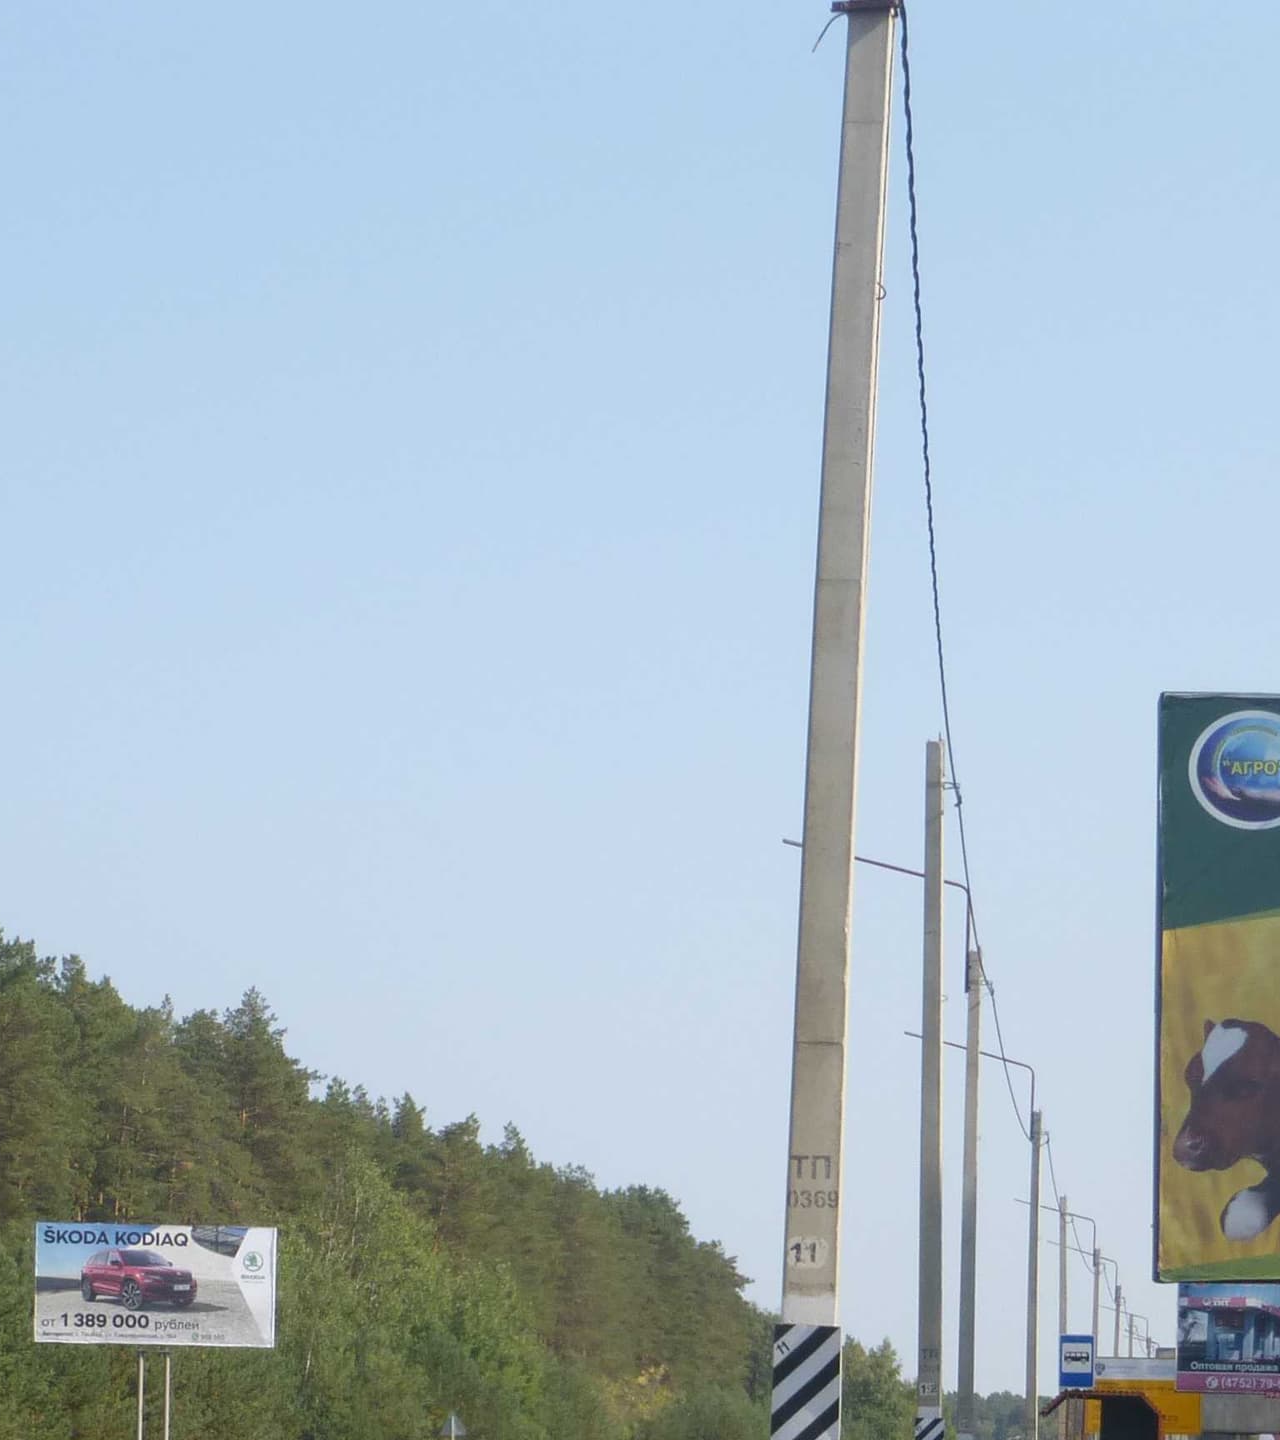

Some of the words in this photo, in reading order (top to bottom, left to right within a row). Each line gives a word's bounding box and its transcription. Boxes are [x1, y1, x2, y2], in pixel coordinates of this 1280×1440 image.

[789, 1154, 832, 1180] ТП
[43, 1225, 109, 1245] ŠKODA
[114, 1231, 189, 1247] KODIAQ
[41, 1319, 56, 1328] от
[74, 1313, 107, 1328] 389
[112, 1314, 150, 1329] 000
[1190, 1360, 1233, 1371] Оптовая
[1235, 1362, 1278, 1373] продажа
[1221, 1374, 1257, 1389] (4752)
